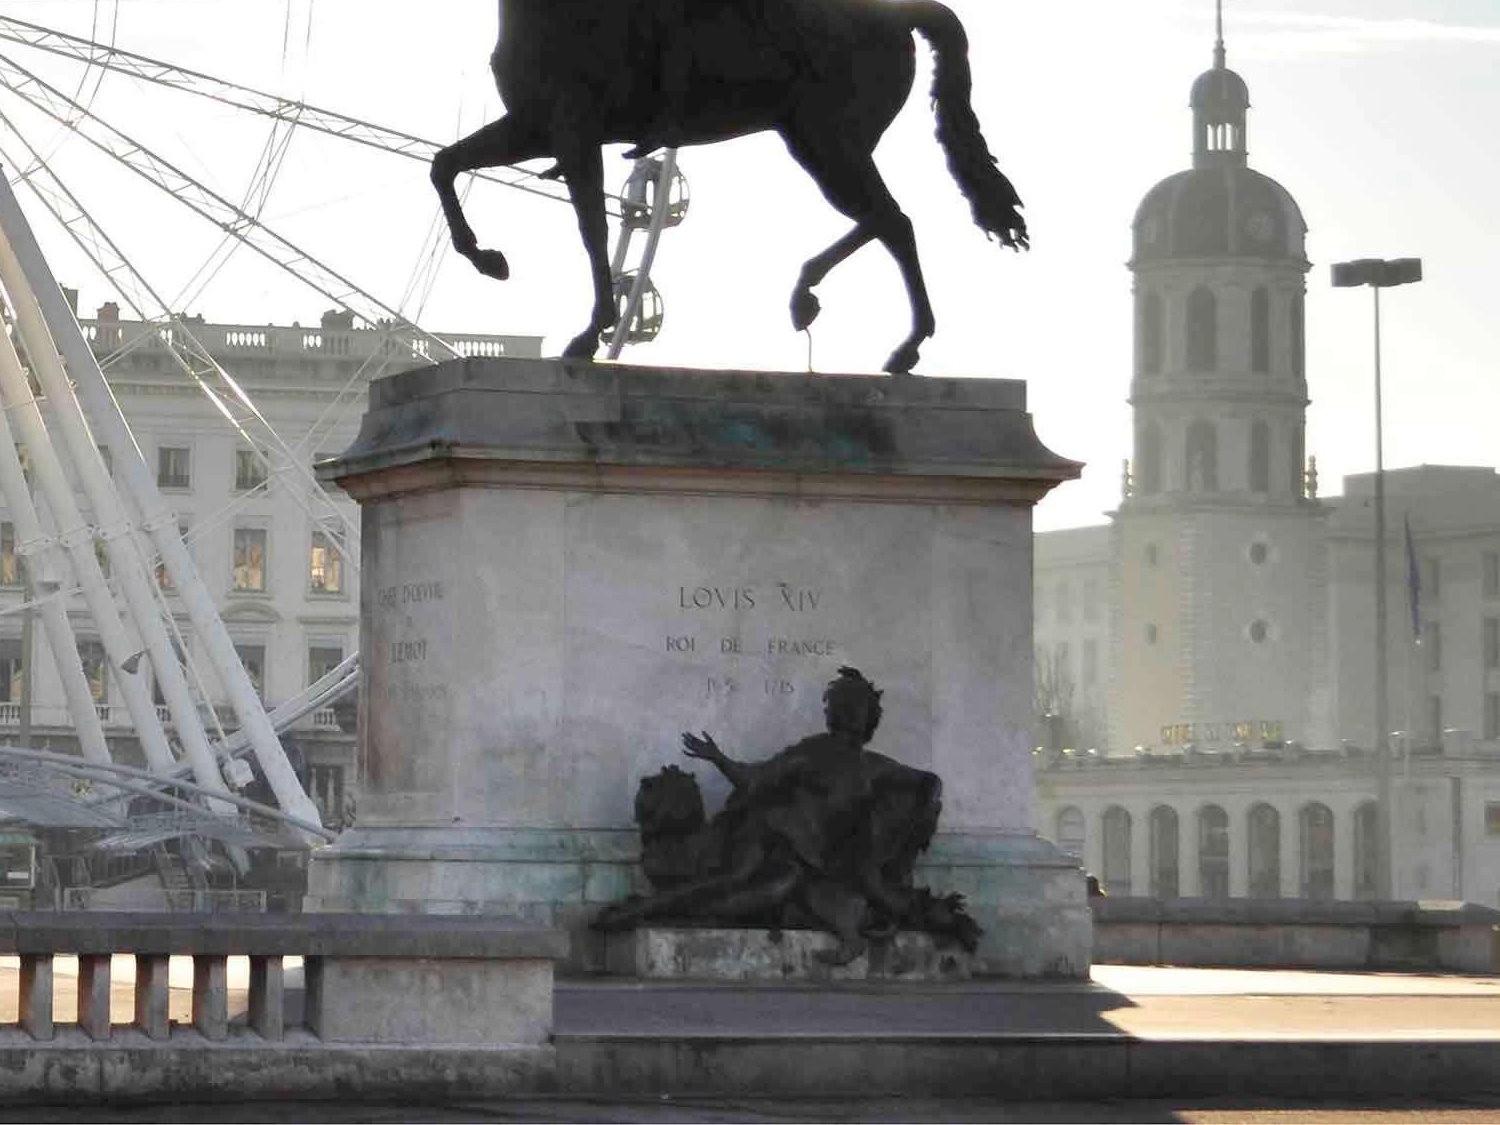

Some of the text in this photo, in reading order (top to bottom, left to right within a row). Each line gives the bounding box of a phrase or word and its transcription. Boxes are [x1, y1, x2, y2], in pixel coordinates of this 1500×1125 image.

[679, 586, 821, 611] LOVIS XIV
[666, 636, 837, 655] ROI DE FRANCE
